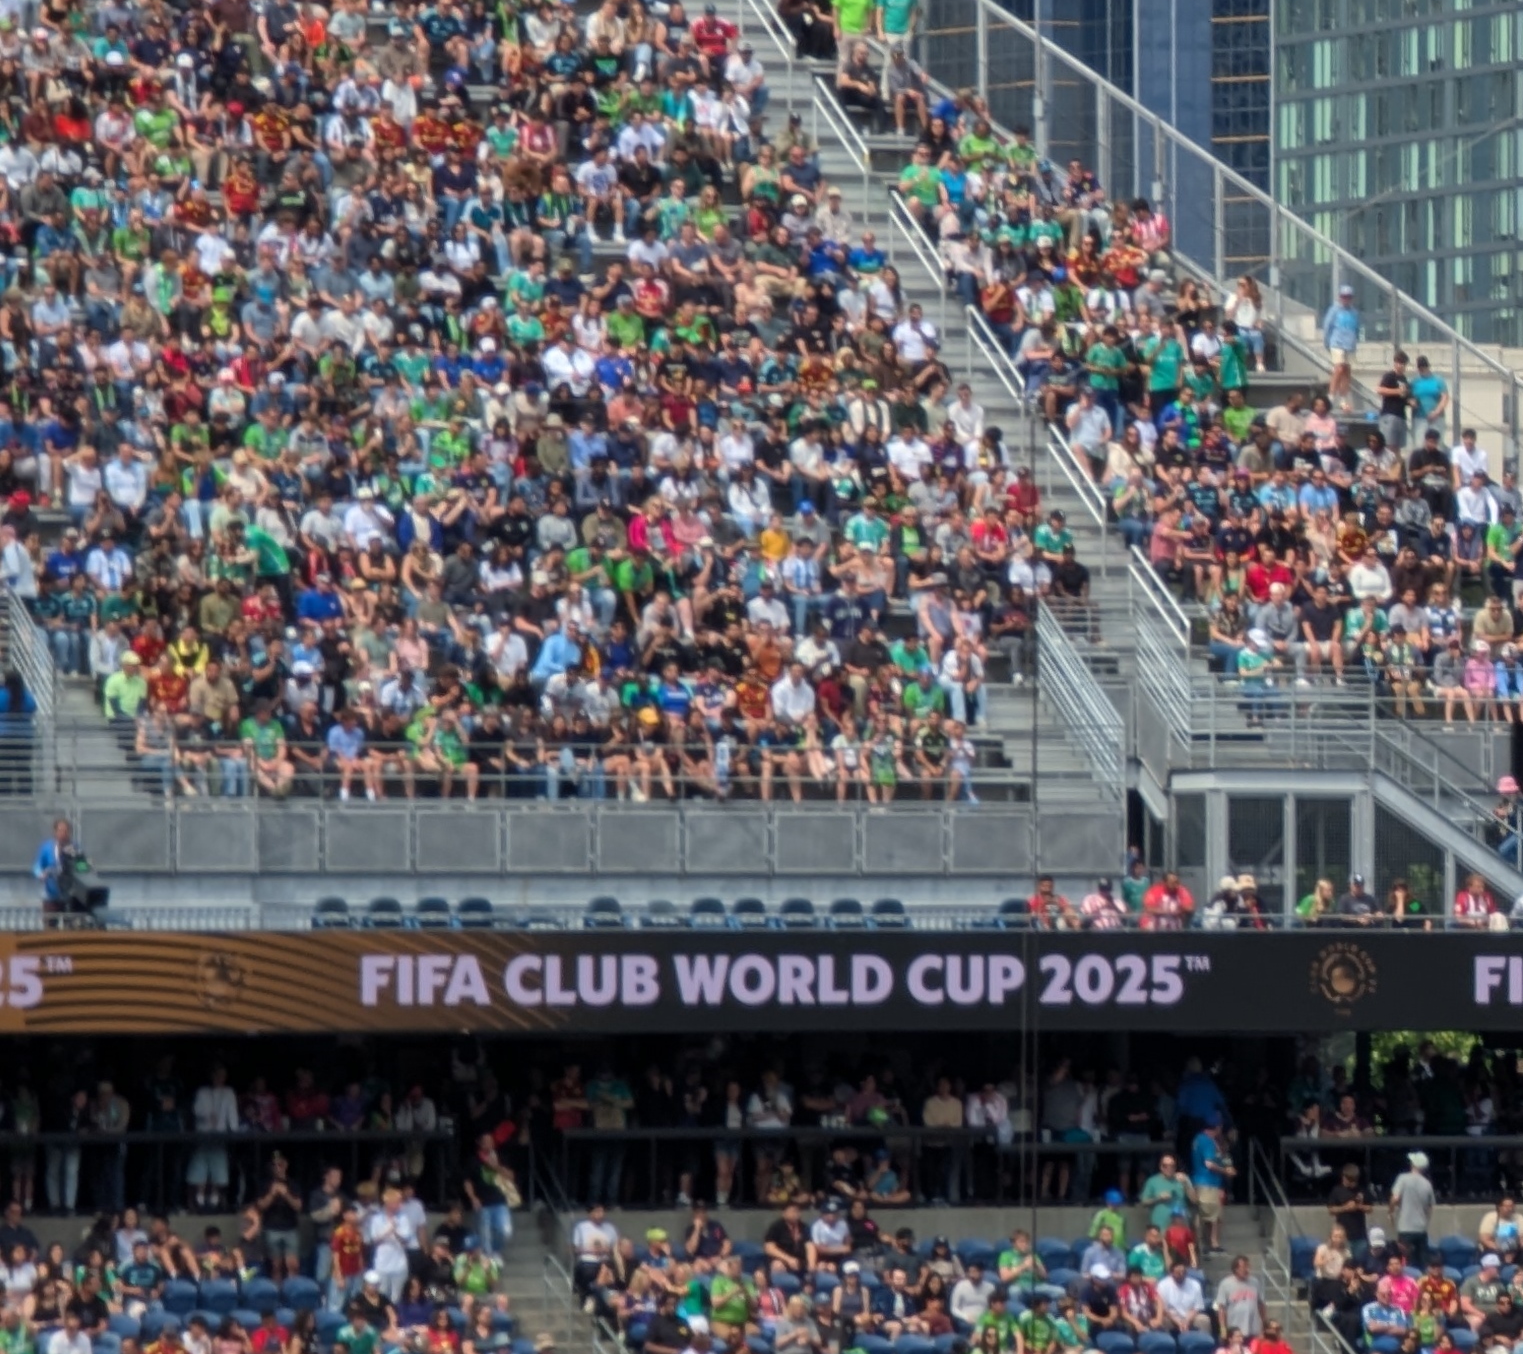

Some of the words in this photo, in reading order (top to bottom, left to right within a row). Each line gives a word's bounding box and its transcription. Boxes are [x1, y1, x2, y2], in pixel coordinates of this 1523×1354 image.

[361, 954, 491, 1005] FIFA
[504, 954, 660, 1005] CLUB
[672, 954, 894, 1005] WORLD
[907, 954, 1025, 1004] CUP
